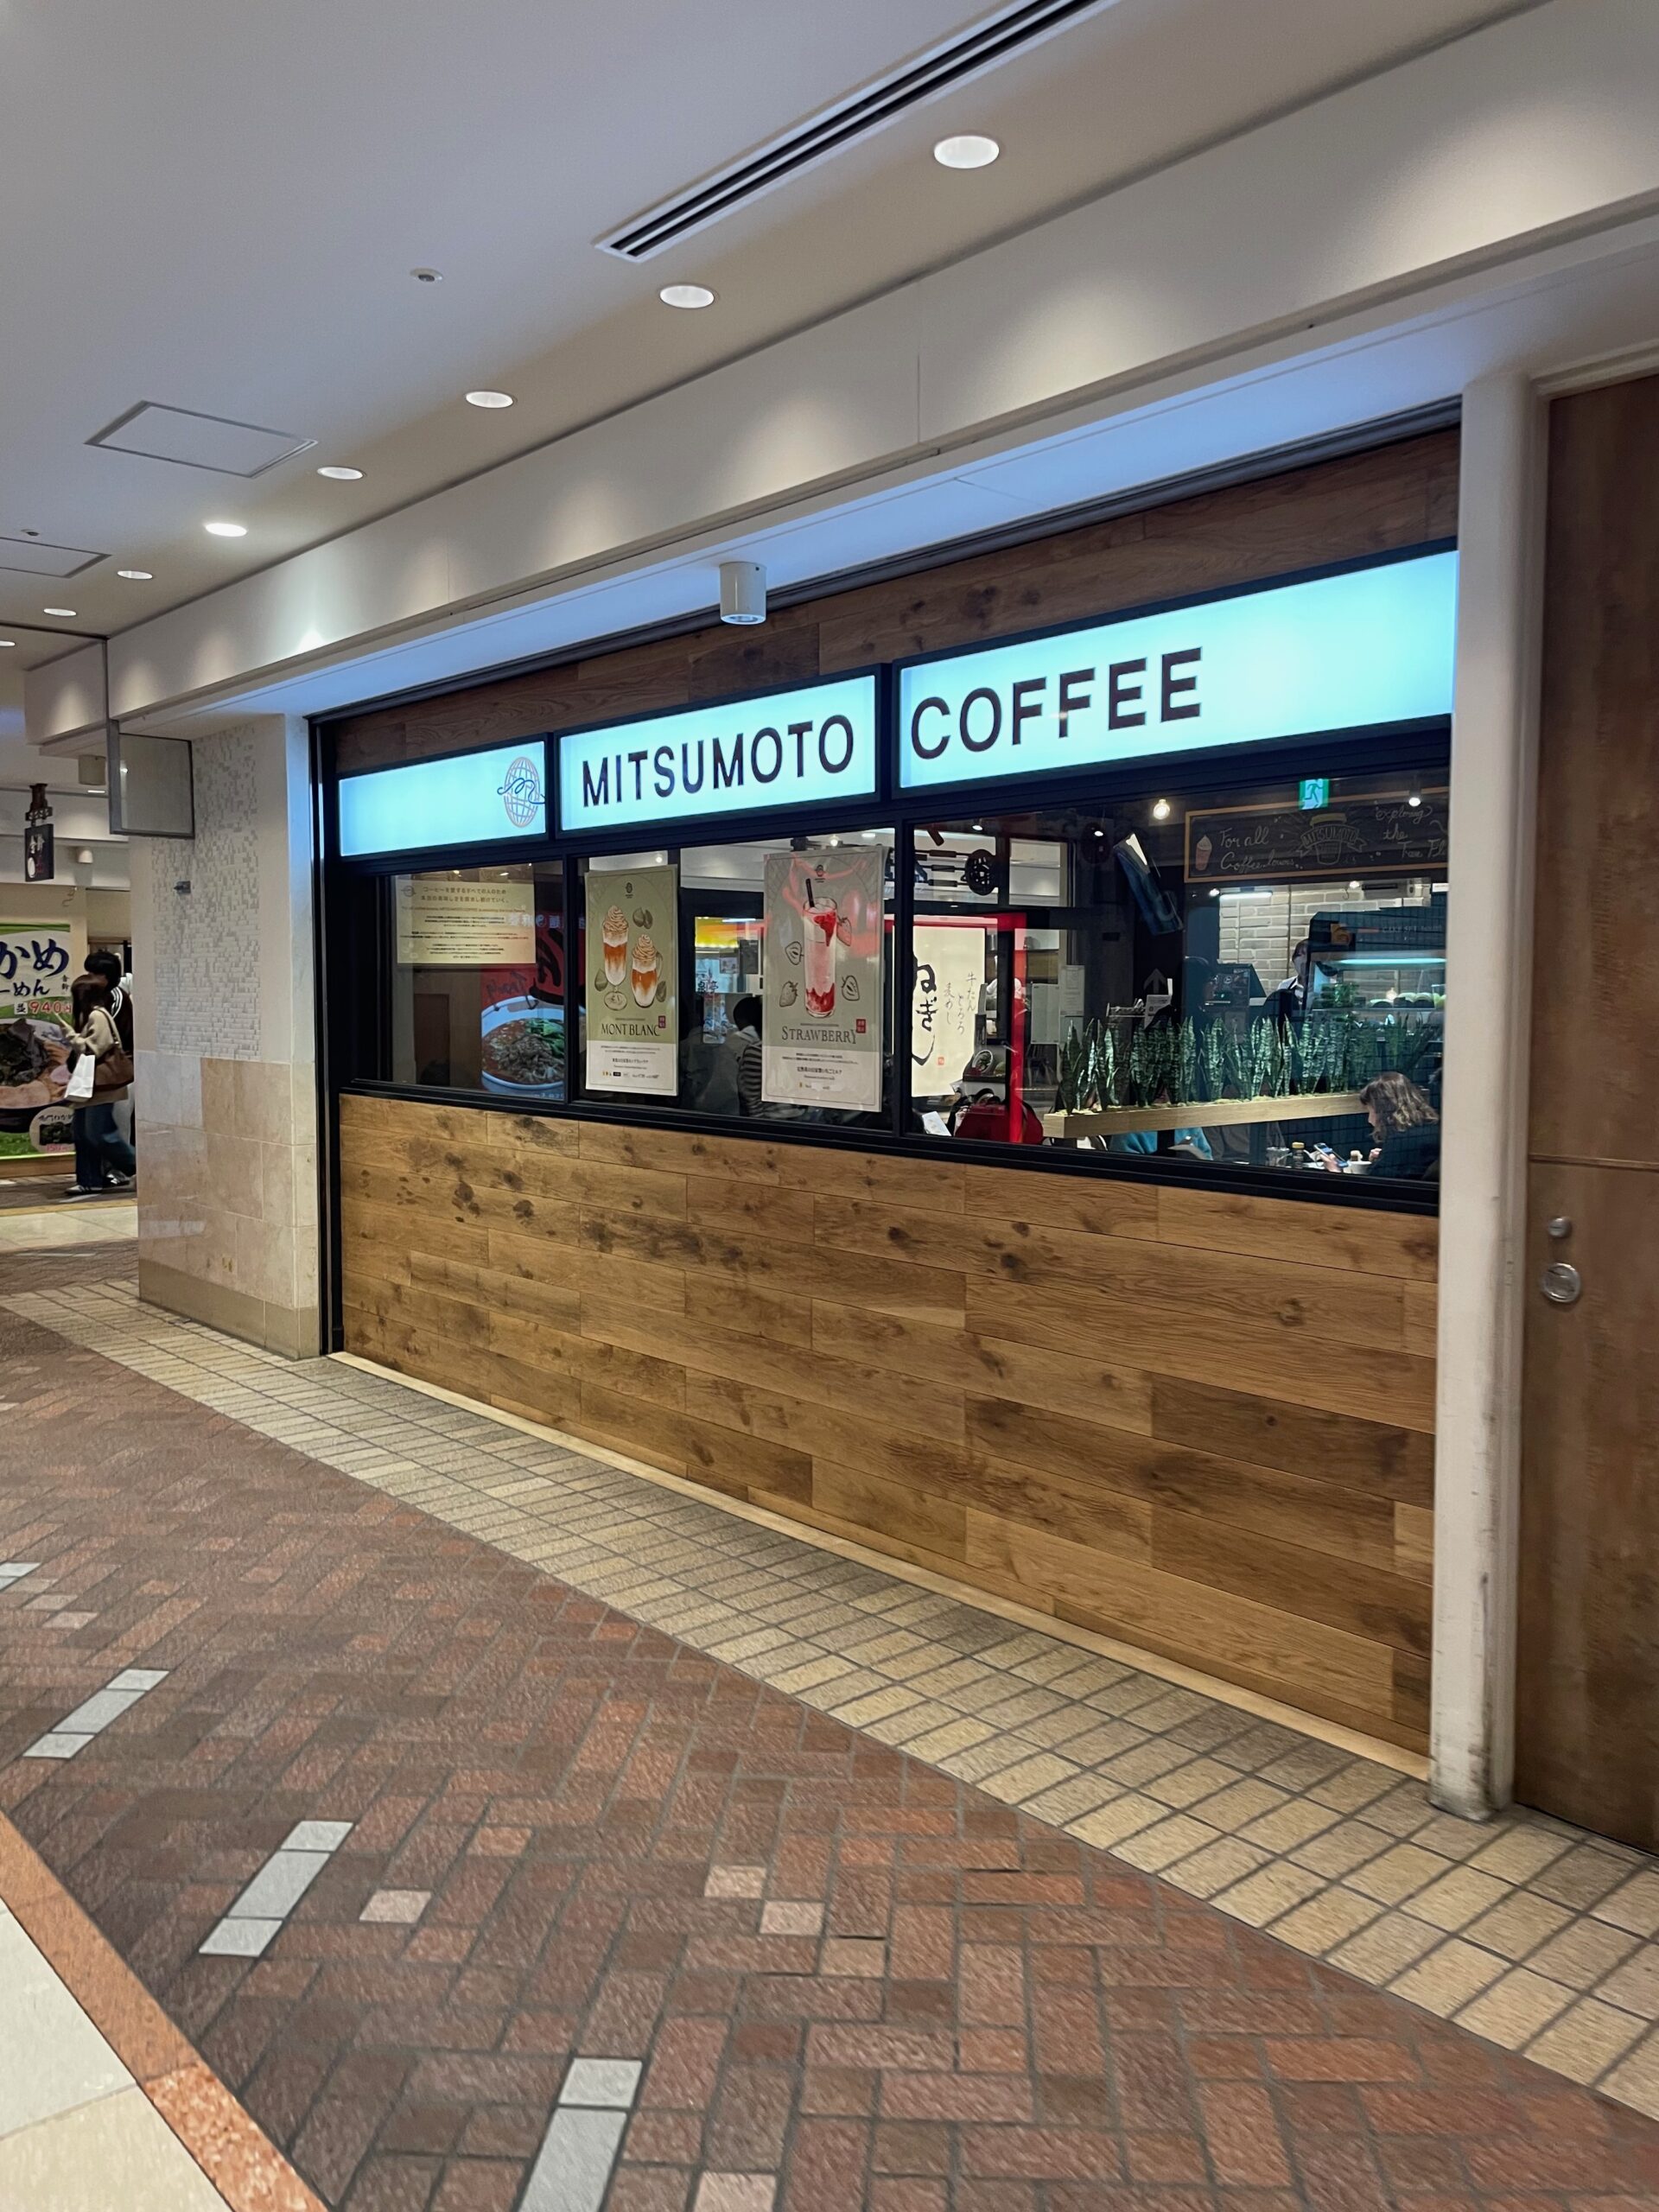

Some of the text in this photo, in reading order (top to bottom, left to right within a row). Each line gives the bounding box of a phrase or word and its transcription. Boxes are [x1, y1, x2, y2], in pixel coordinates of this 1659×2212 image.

[582, 646, 1203, 808] MITSUMOTO COFFEE
[1244, 825, 1270, 847] all
[1382, 823, 1408, 840] the
[601, 1023, 627, 1035] MONT
[781, 1026, 857, 1045] STRAWBERRY
